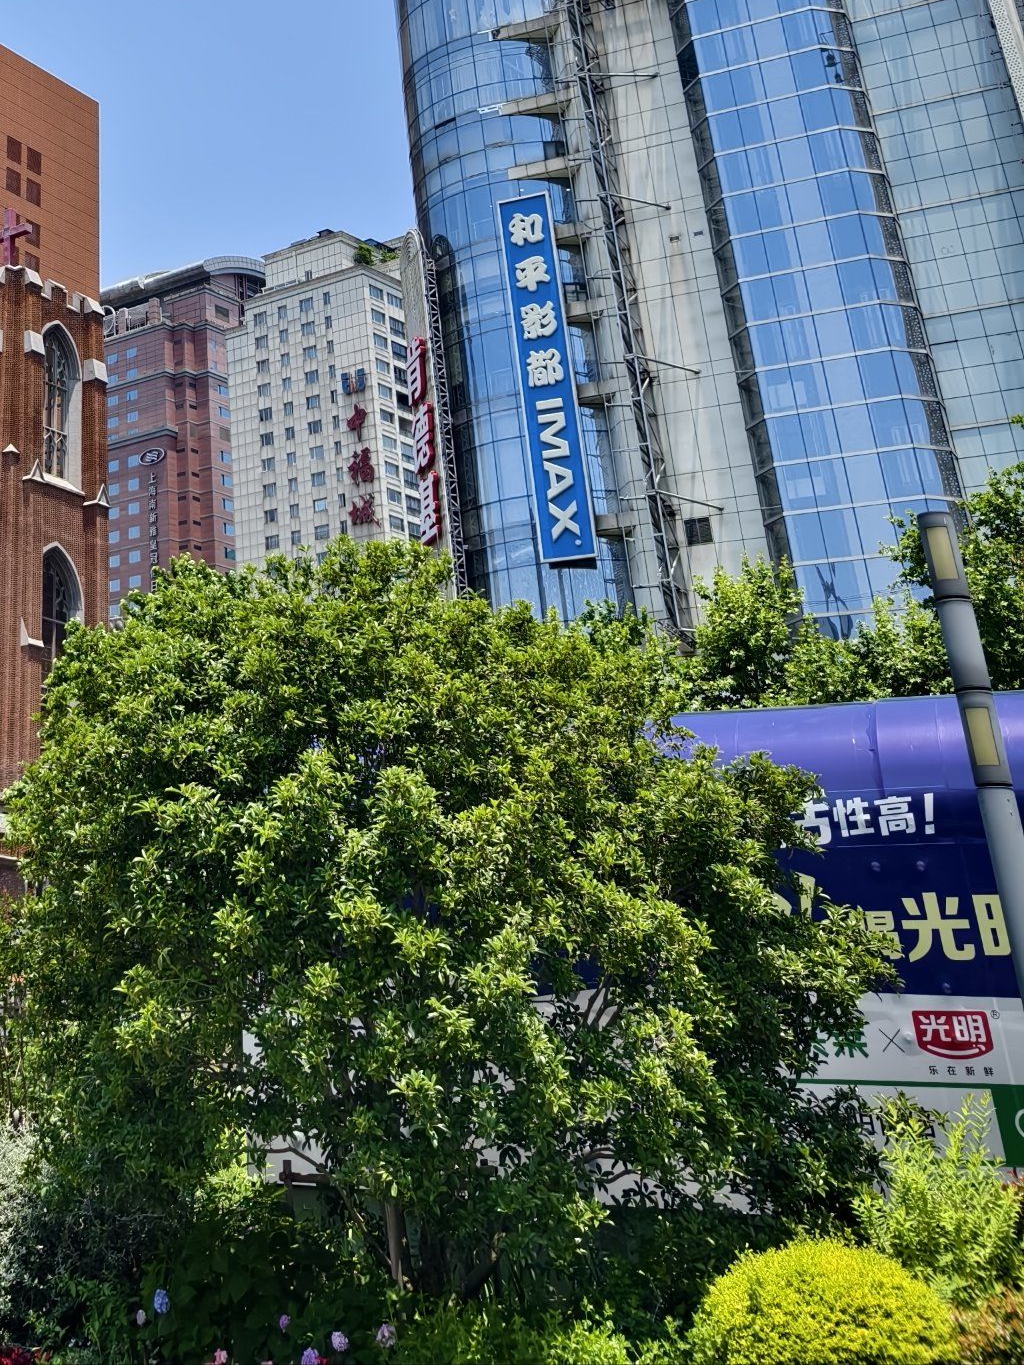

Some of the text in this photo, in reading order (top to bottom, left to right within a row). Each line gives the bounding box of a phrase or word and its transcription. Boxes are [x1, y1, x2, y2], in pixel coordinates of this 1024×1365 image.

[508, 212, 582, 546] 和平影都 IMAX
[345, 402, 382, 529] 中福城
[918, 1014, 986, 1043] 光明
[928, 1065, 995, 1077] 乐在新鲜
